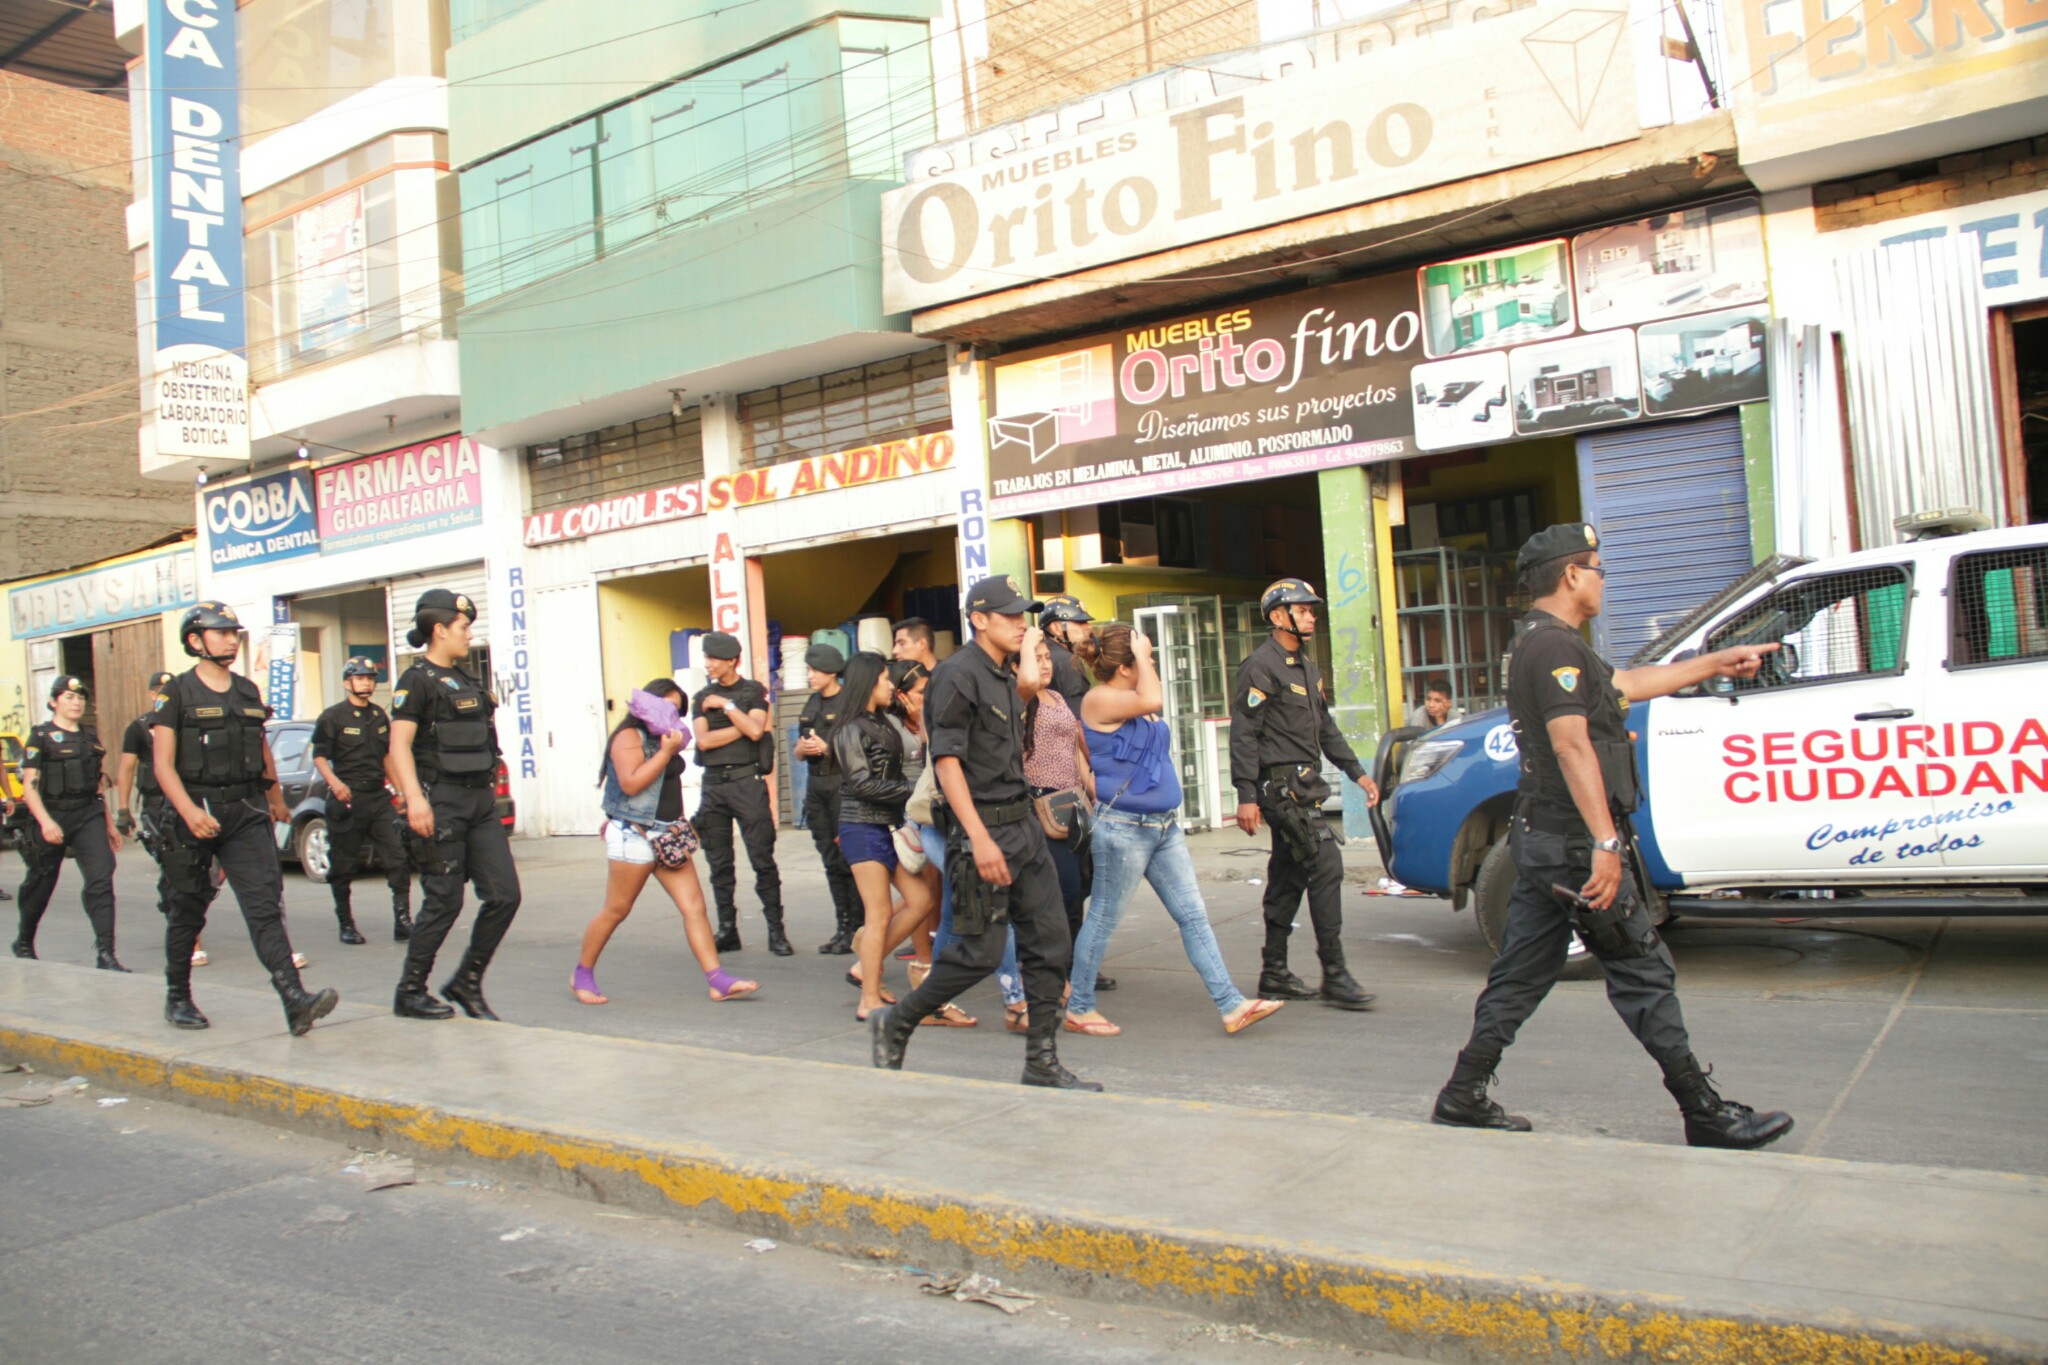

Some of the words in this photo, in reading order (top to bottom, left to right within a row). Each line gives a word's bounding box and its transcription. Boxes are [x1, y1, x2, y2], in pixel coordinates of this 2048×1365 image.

[1743, 0, 2048, 97] FER
[899, 176, 1158, 285] Orito
[1169, 94, 1434, 221] Fino
[981, 131, 1139, 193] MUEBLES
[170, 96, 229, 323] DENTAL
[1120, 333, 1286, 405] Orito
[1275, 307, 1420, 393] fino
[1126, 308, 1252, 354] MUEBLES
[162, 380, 245, 404] OBSTETRICIA
[172, 361, 233, 381] MEDICINA
[161, 403, 247, 425] LABORATORIO
[182, 426, 229, 445] BOTICA
[1134, 409, 1251, 444] Diseñamos
[1257, 403, 1290, 424] sus
[1296, 385, 1398, 424] proyectos
[318, 436, 479, 509] FARMACIA
[707, 466, 778, 512] SOL
[790, 431, 956, 497] ANDINO
[993, 471, 1054, 496] TRABAJOS
[1055, 468, 1071, 487] EN
[1073, 459, 1140, 483] MELAMINA,
[1142, 450, 1187, 473] METAL,
[1258, 424, 1354, 454] POSFORMADO
[208, 477, 313, 533] COBBA
[332, 481, 470, 533] GLOBALFARMA
[524, 482, 701, 545] ALCOHOLES
[960, 488, 987, 570] RON
[212, 537, 265, 565] CLÍNICA
[267, 529, 320, 554] DENTAL
[509, 567, 527, 631] RON
[713, 531, 742, 667] ALC
[514, 634, 527, 647] DE
[280, 665, 291, 717] DENTAL
[514, 649, 537, 779] QUEMAR
[1488, 730, 1518, 754] 42
[1722, 718, 2048, 767] SEGURIDA
[1723, 758, 2048, 804] CIUDADAN
[1806, 799, 2017, 851] Compromiso
[1848, 845, 1885, 866] de
[1896, 832, 1986, 860] todos
